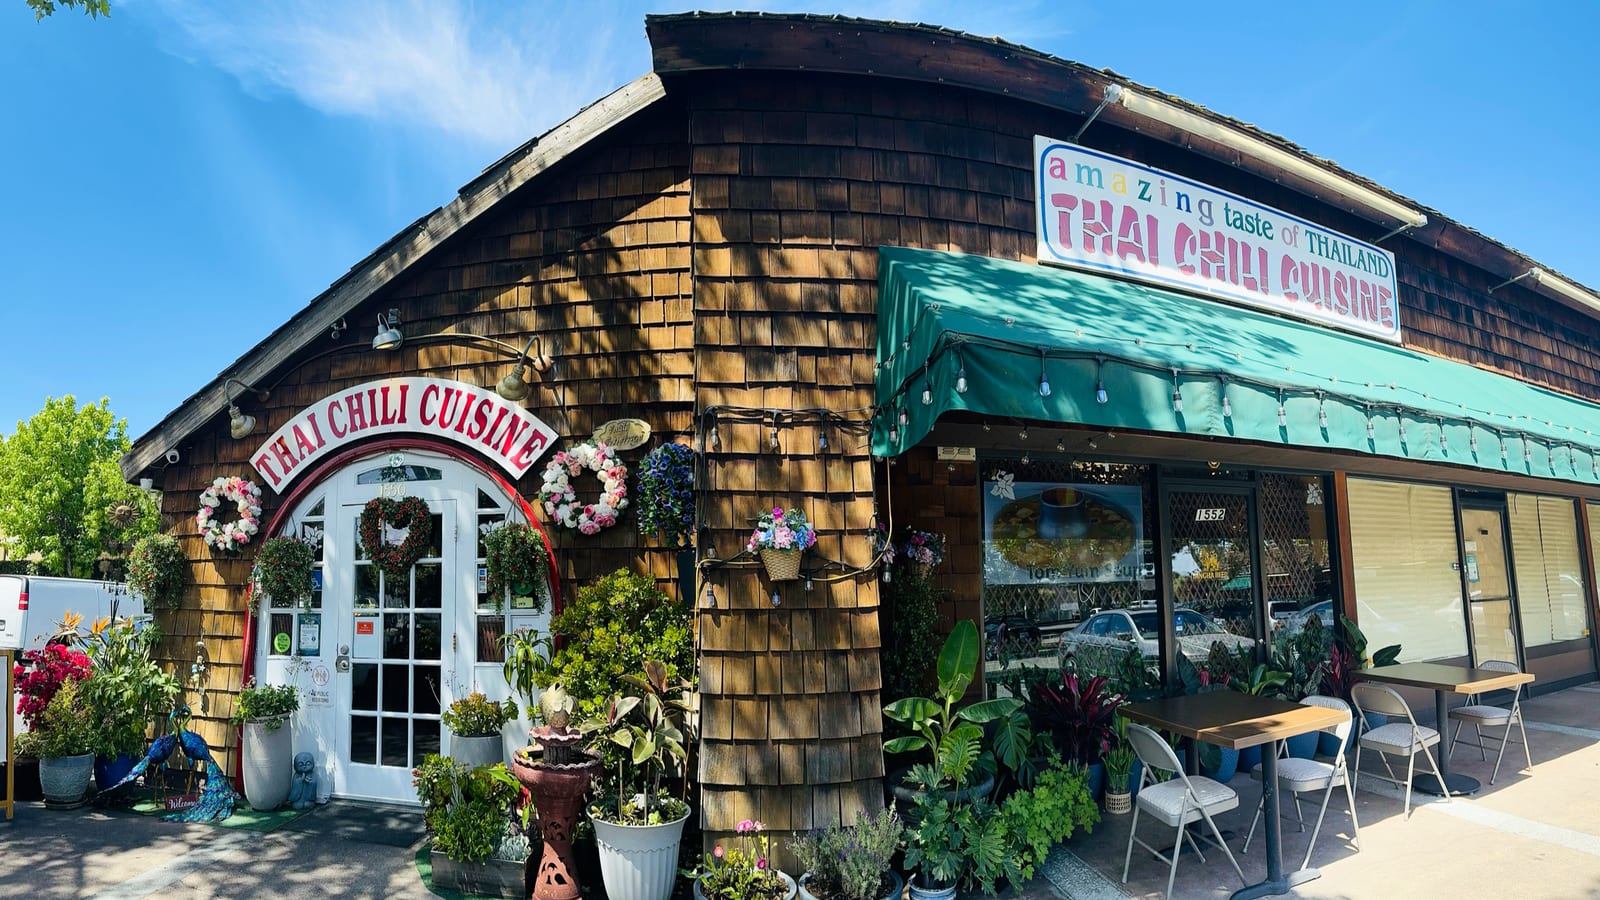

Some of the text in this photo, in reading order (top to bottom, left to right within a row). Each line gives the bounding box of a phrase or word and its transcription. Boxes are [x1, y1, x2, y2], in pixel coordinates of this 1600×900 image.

[1049, 156, 1389, 279] amazing taste of THAILAND
[1051, 193, 1394, 328] THAI CHILI CUISINE
[255, 384, 549, 487] THAI CHILI CUISINE
[379, 483, 407, 497] 1550
[1198, 509, 1225, 520] 1552
